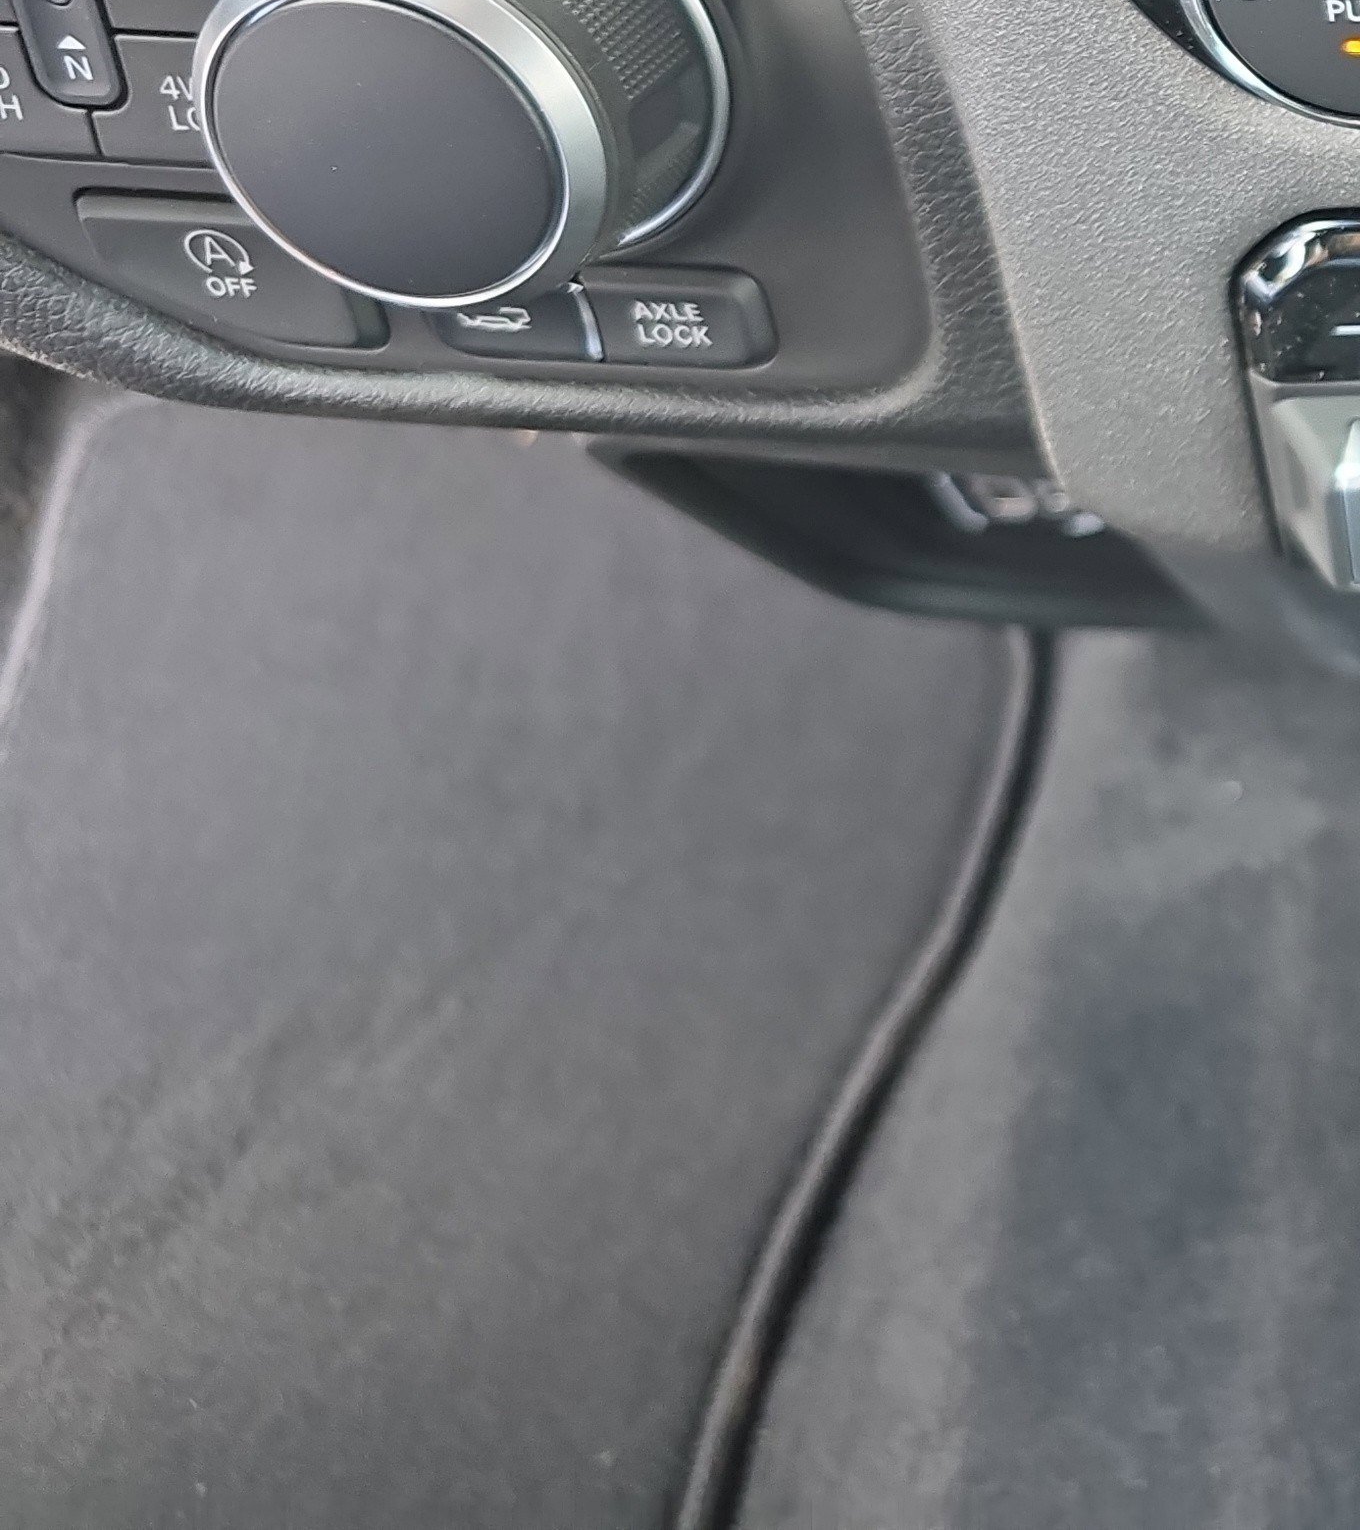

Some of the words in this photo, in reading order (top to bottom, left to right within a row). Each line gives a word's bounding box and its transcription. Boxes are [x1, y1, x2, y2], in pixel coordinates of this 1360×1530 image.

[62, 55, 94, 81] N
[205, 276, 258, 298] OFF
[632, 300, 704, 322] AXLE
[636, 322, 713, 346] LOCK
